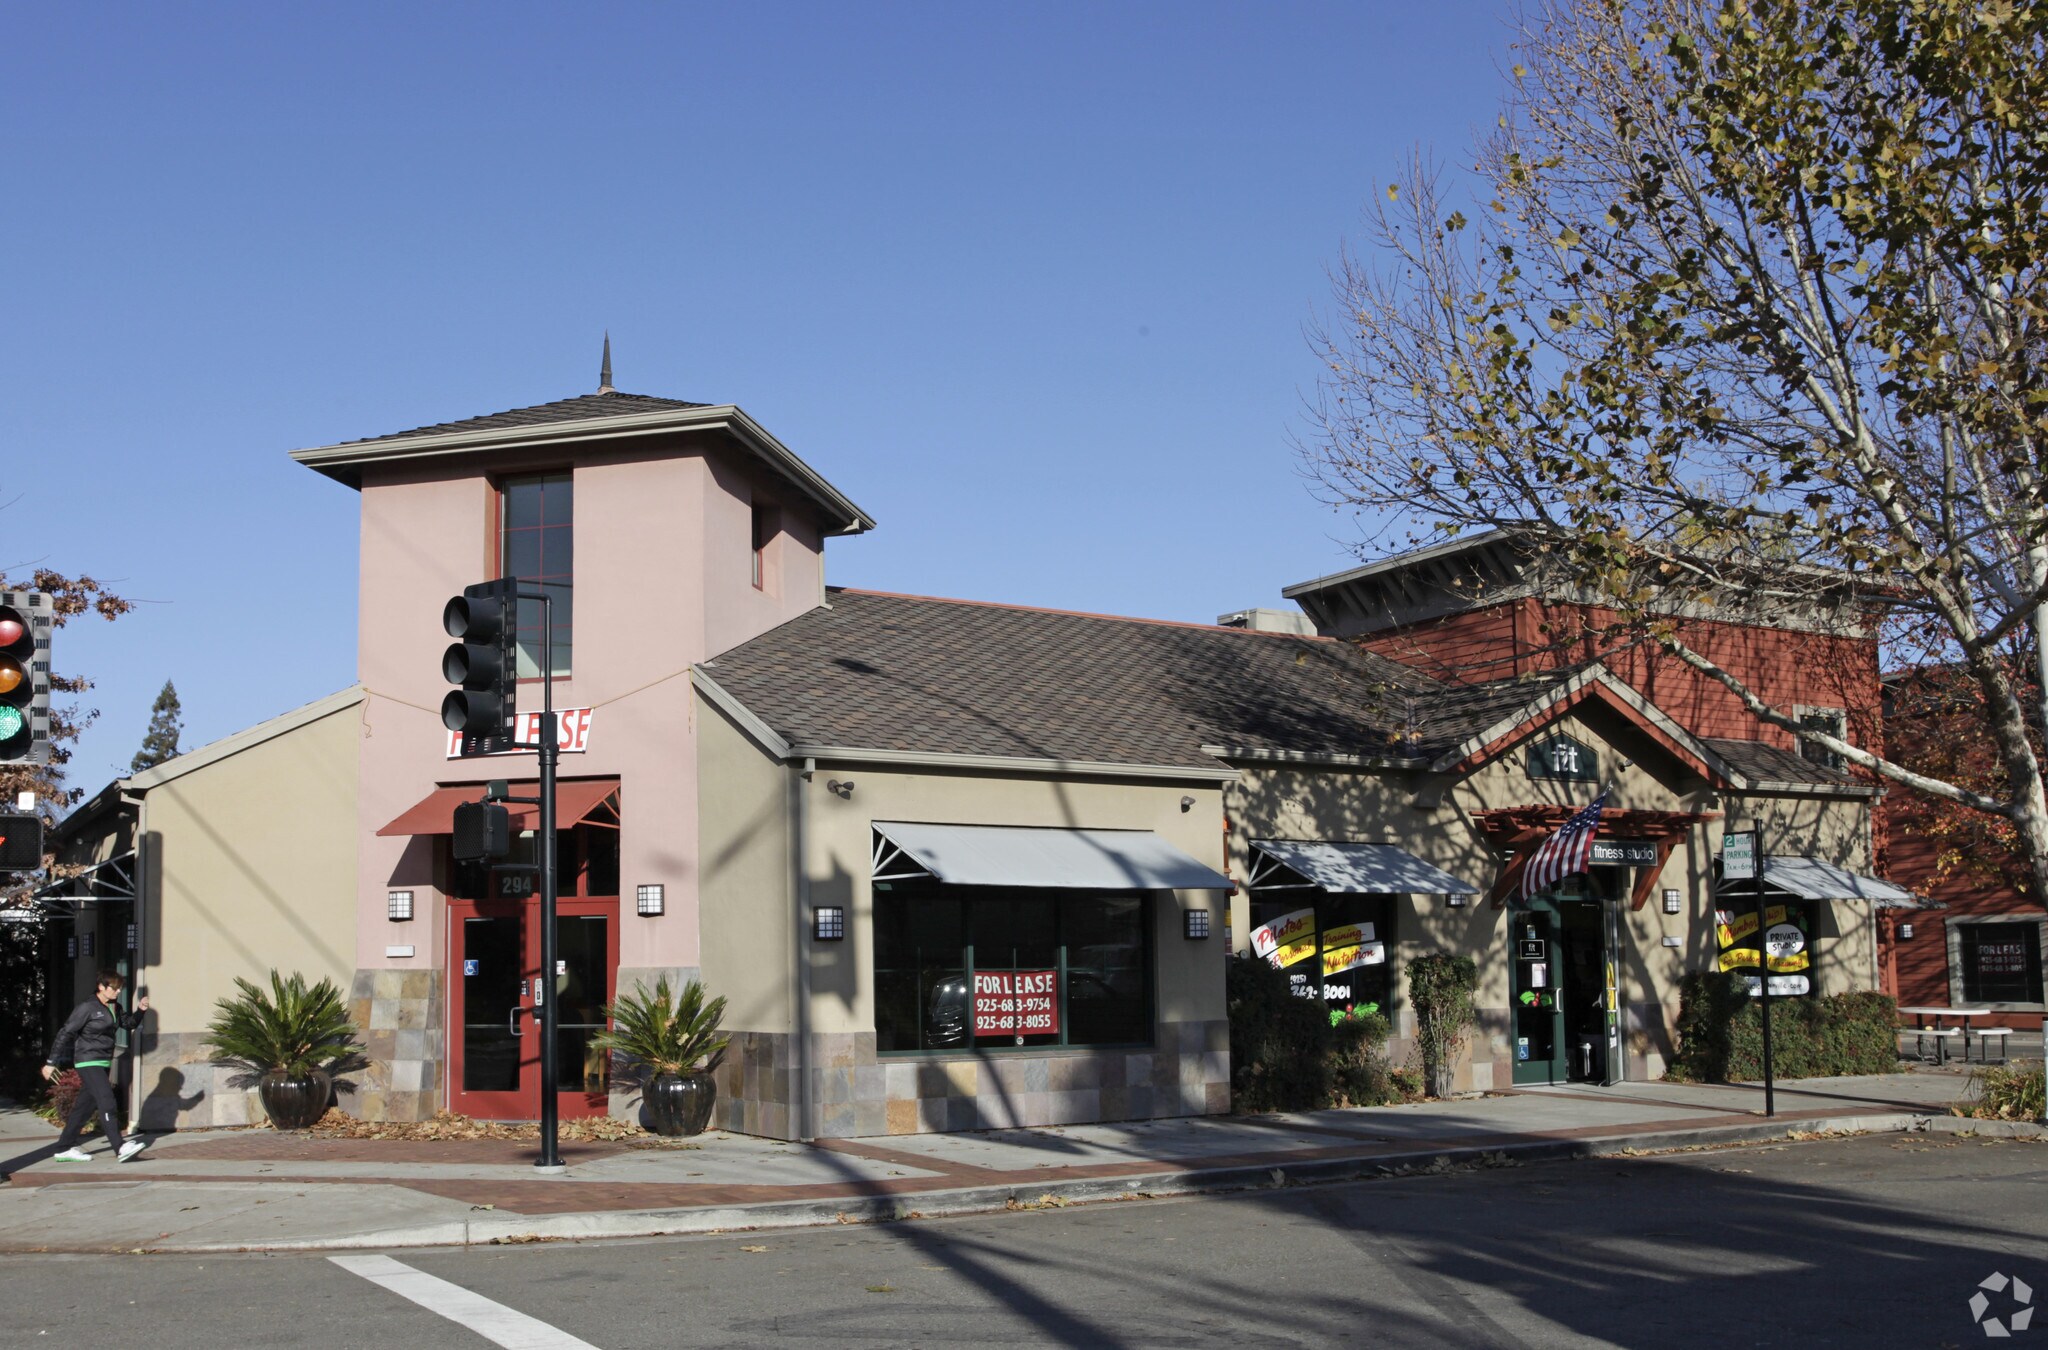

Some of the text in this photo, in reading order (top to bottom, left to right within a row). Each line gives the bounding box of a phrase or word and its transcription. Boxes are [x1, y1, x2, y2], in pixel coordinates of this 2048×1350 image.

[1725, 835, 1733, 846] 2
[1594, 845, 1654, 860] fitness studio
[1726, 850, 1753, 860] PARKING
[502, 876, 531, 893] 294
[1256, 918, 1308, 951] Pilates
[1323, 929, 1366, 946] Training
[1770, 932, 1799, 942] PRIVATE
[1272, 939, 1311, 967] Personal
[1772, 941, 1797, 951] STUDIO
[1326, 947, 1375, 969] Nutrition
[974, 974, 1053, 994] FOR LEASE
[976, 997, 1051, 1012] 925-683-9754
[976, 1014, 1051, 1029] 925-683-8055
